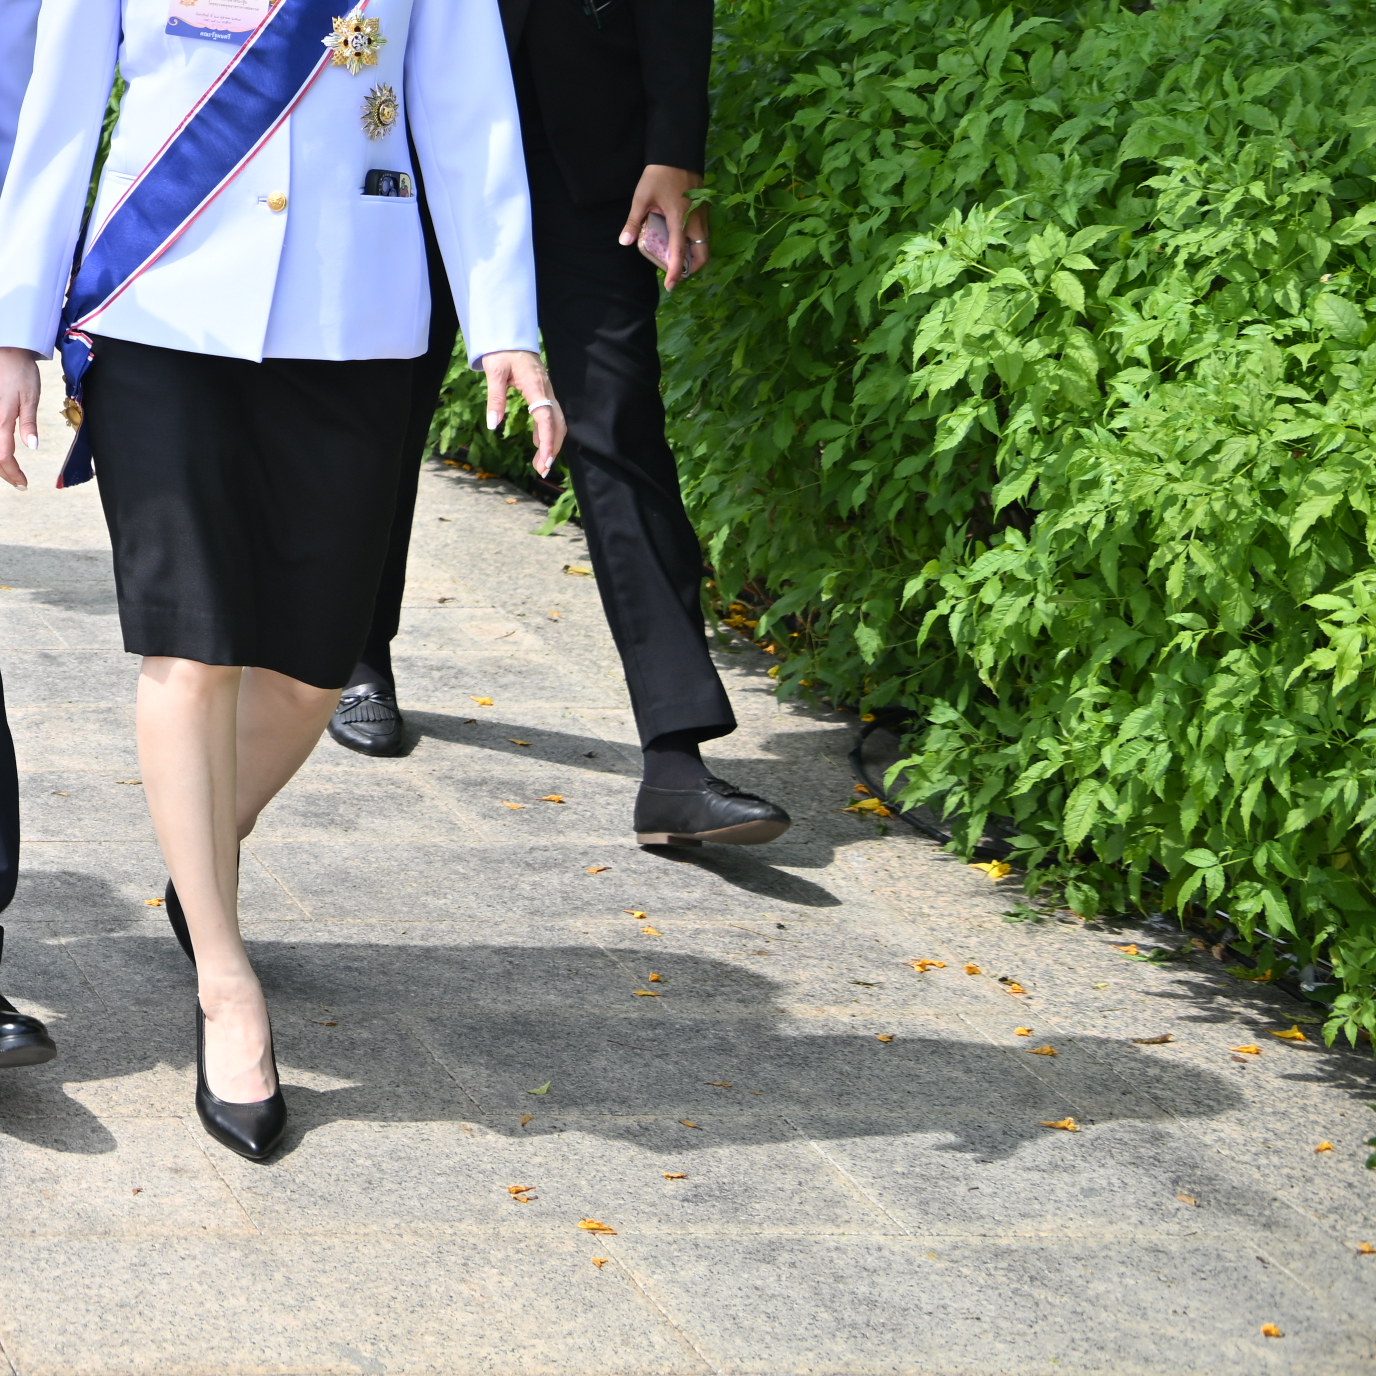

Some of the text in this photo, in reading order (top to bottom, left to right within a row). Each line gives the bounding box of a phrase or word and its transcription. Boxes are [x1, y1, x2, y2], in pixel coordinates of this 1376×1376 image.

[199, 30, 232, 40] คณะรัฐมนตรี
